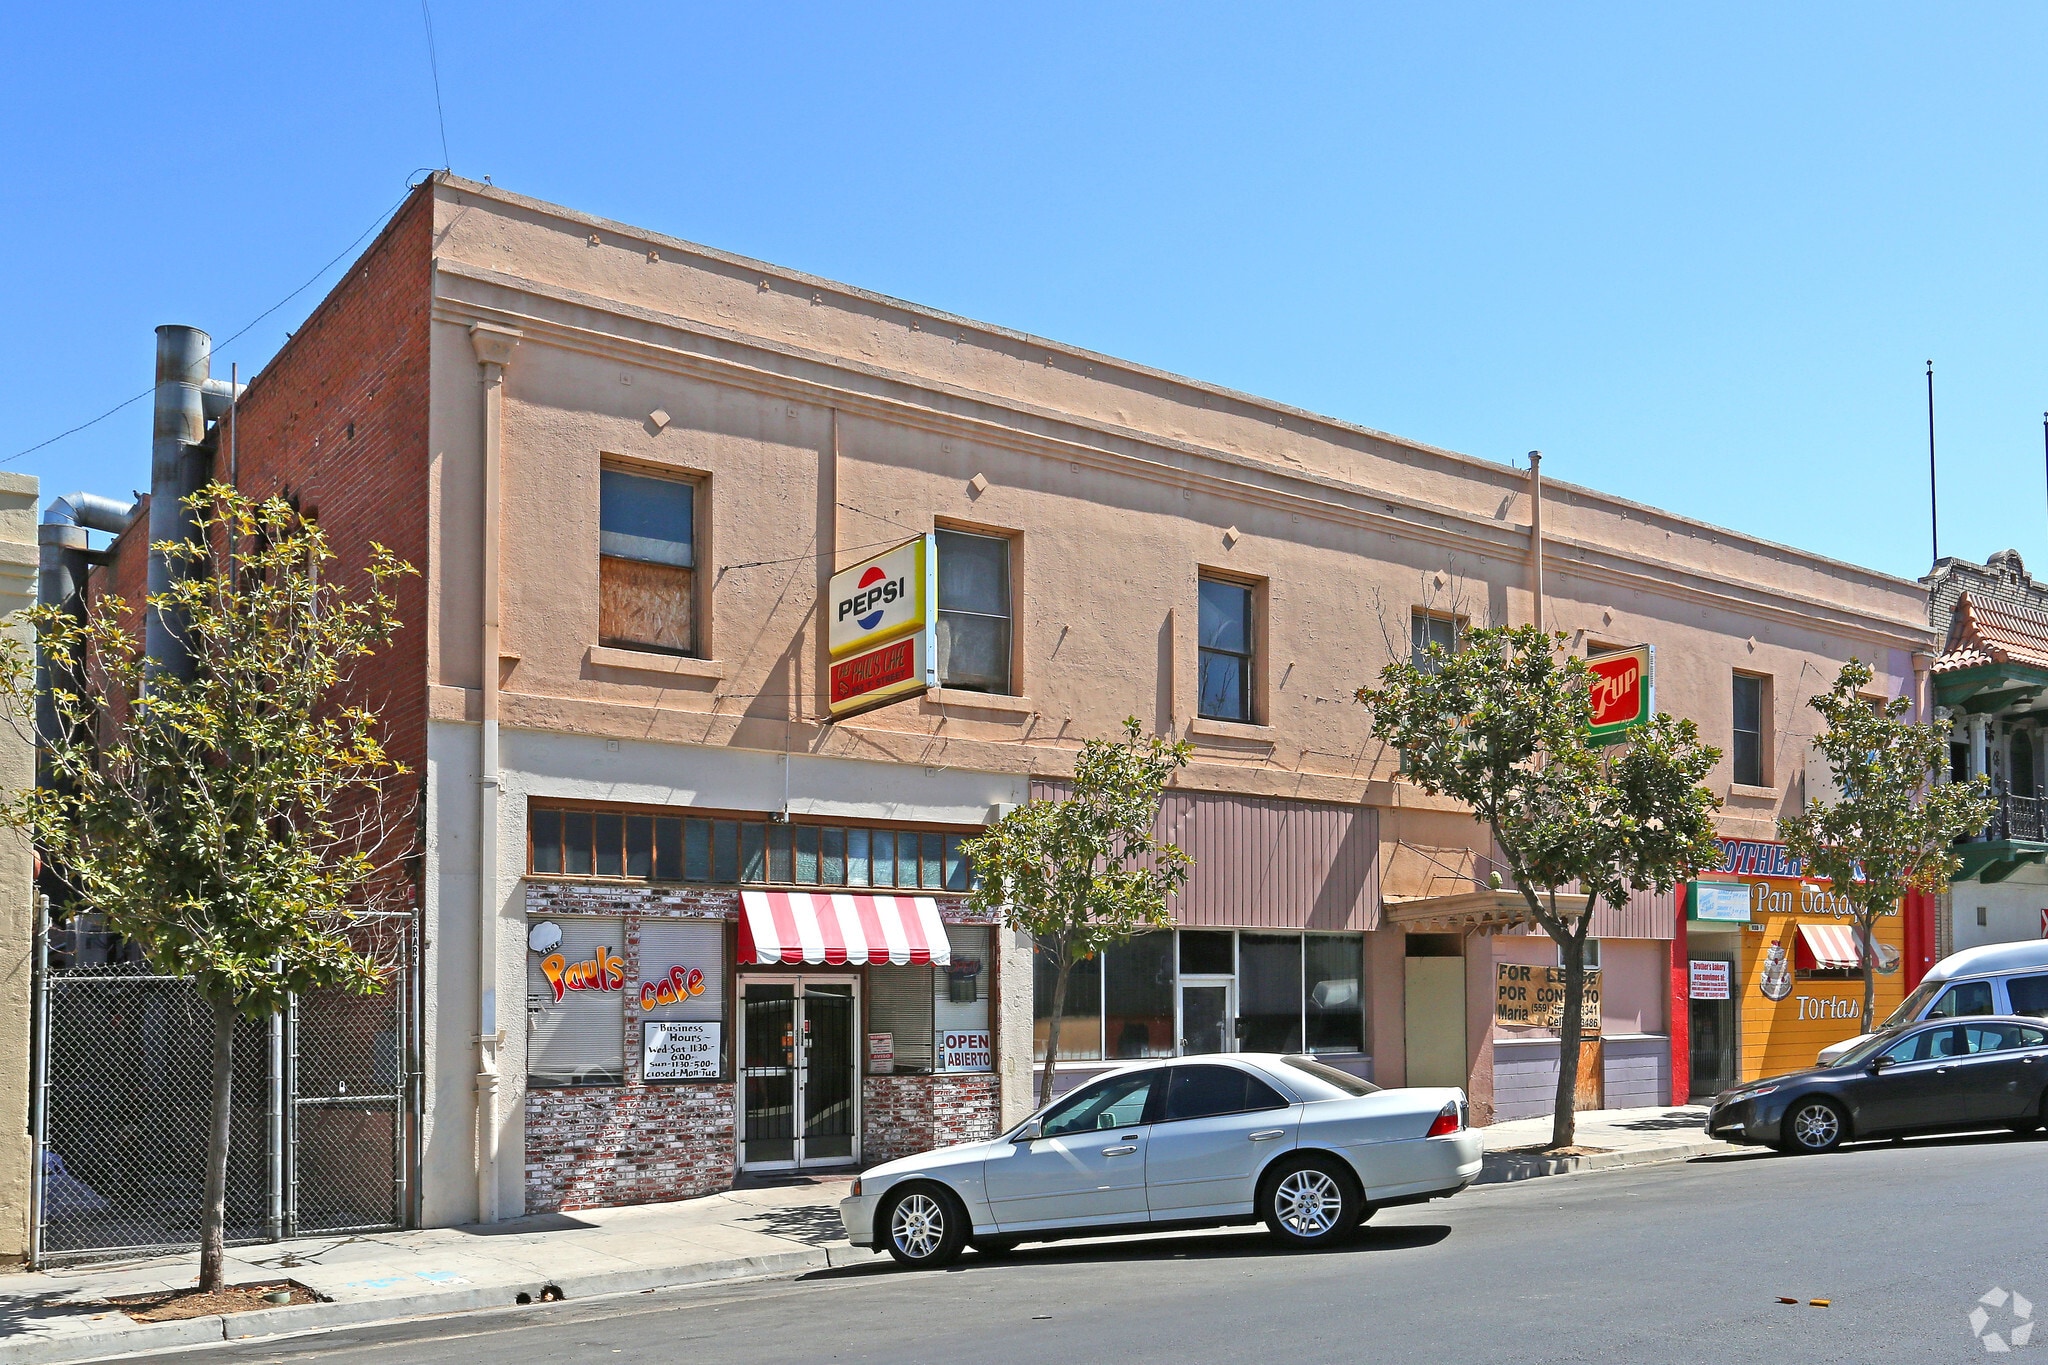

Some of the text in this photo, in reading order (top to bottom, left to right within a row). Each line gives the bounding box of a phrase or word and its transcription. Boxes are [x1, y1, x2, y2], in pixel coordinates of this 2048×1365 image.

[838, 577, 905, 622] PEPSI
[852, 653, 881, 684] PAUL'S
[884, 644, 906, 672] CAFE
[876, 670, 905, 686] STREET
[1751, 882, 1793, 912] Pan
[540, 945, 705, 1011] Paul's cafe
[1499, 964, 1531, 981] FOR
[1499, 986, 1599, 1004] POR CONTO
[1498, 1004, 1529, 1021] Maria
[1531, 1003, 1550, 1014] (559)
[1796, 995, 1860, 1020] Tortas
[660, 1023, 704, 1032] Business
[669, 1033, 702, 1042] Hours
[945, 1034, 989, 1049] OPEN
[947, 1052, 990, 1066] ABIERTO
